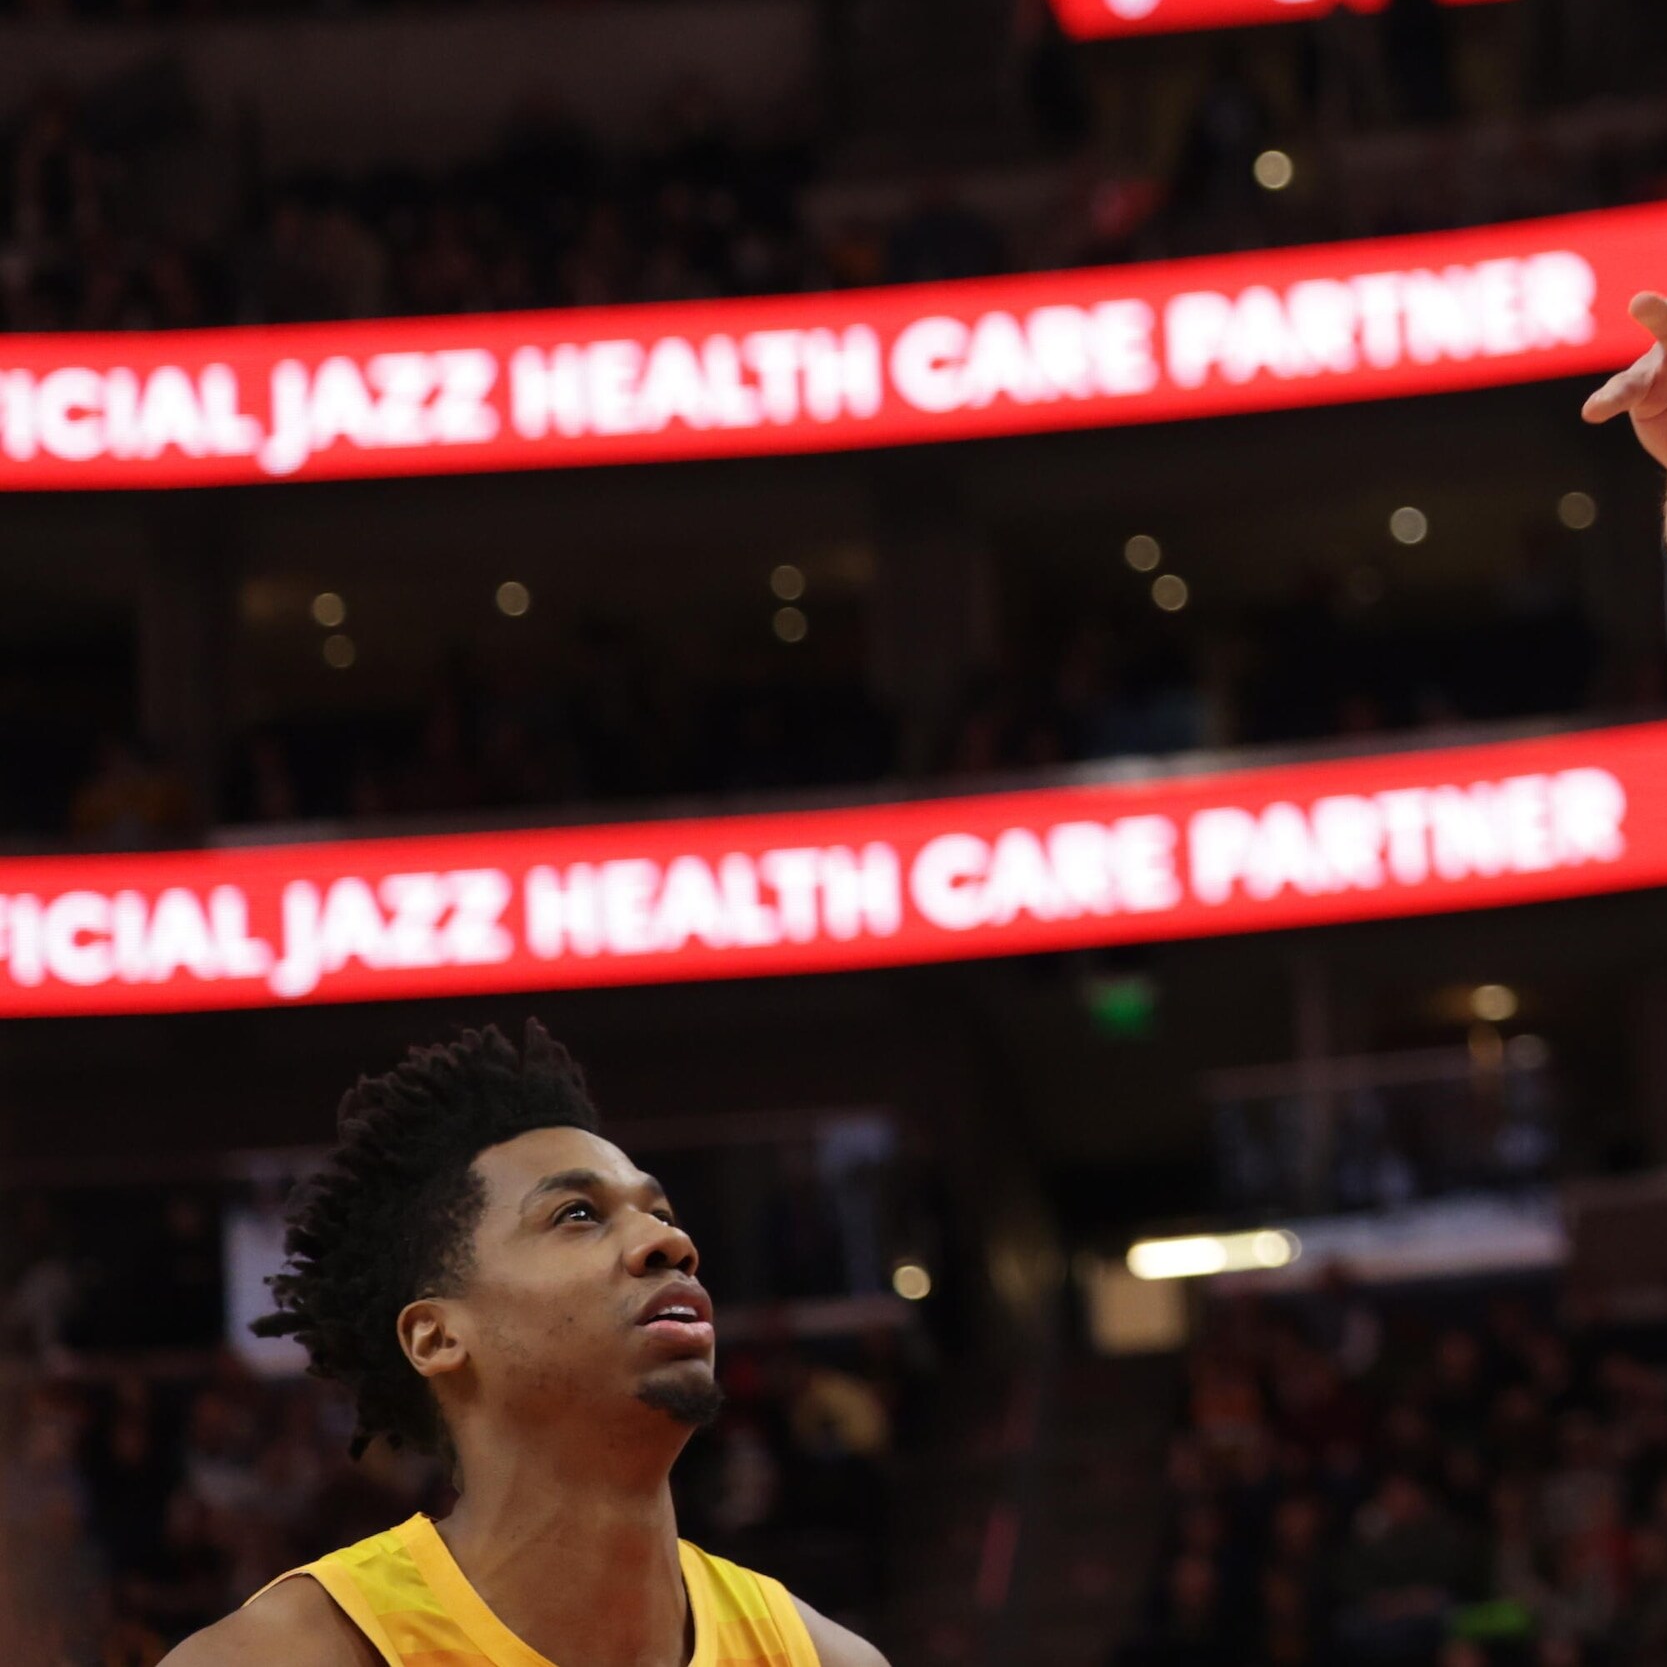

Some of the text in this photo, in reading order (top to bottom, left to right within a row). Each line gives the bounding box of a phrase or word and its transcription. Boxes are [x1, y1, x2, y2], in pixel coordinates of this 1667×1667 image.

[0, 250, 1596, 475] ICIAL JAZZ HEALTH CARE PARTNER
[0, 766, 1627, 998] ICIAL JAZZ HEALTH CARE PARTNER
